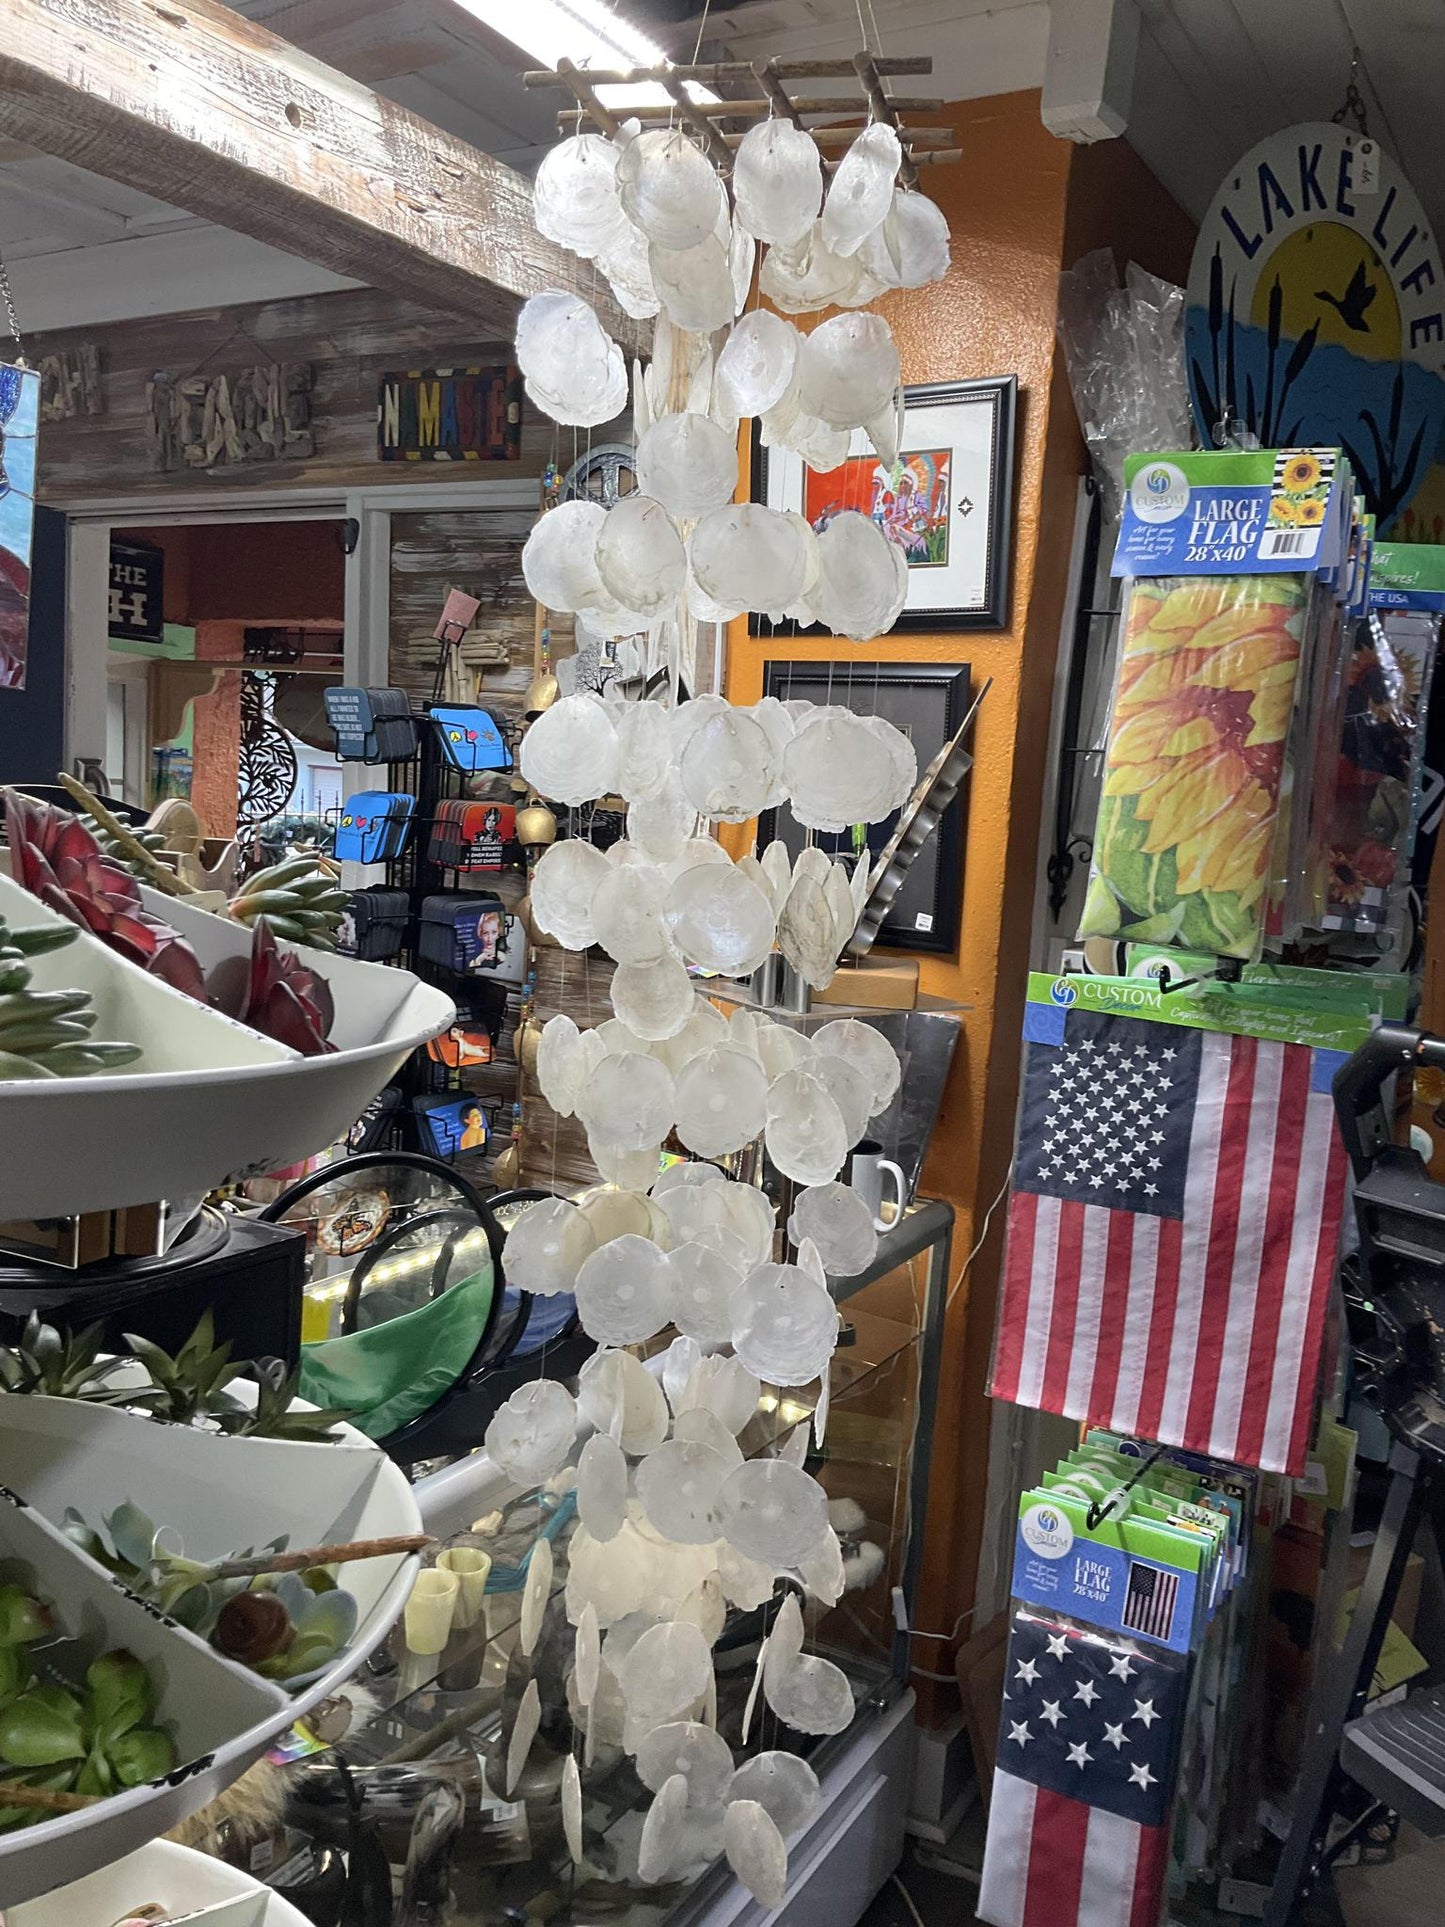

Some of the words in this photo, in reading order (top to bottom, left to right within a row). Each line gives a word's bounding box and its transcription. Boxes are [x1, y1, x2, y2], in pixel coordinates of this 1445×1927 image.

[1221, 144, 1355, 260] LAKE
[1372, 186, 1443, 349] LIFE
[384, 379, 505, 448] NAMASTE
[1136, 494, 1184, 506] CUSTOM
[1194, 499, 1263, 521] LARGE
[1187, 520, 1259, 545] FLAG
[1184, 545, 1252, 562] 28"x40"
[109, 562, 147, 586] HE
[1388, 594, 1409, 604] USA
[1083, 982, 1162, 1009] CUSTOM
[1025, 1527, 1068, 1548] CUSTOM
[1076, 1557, 1112, 1578] LARGE
[1074, 1567, 1112, 1593] FLAG
